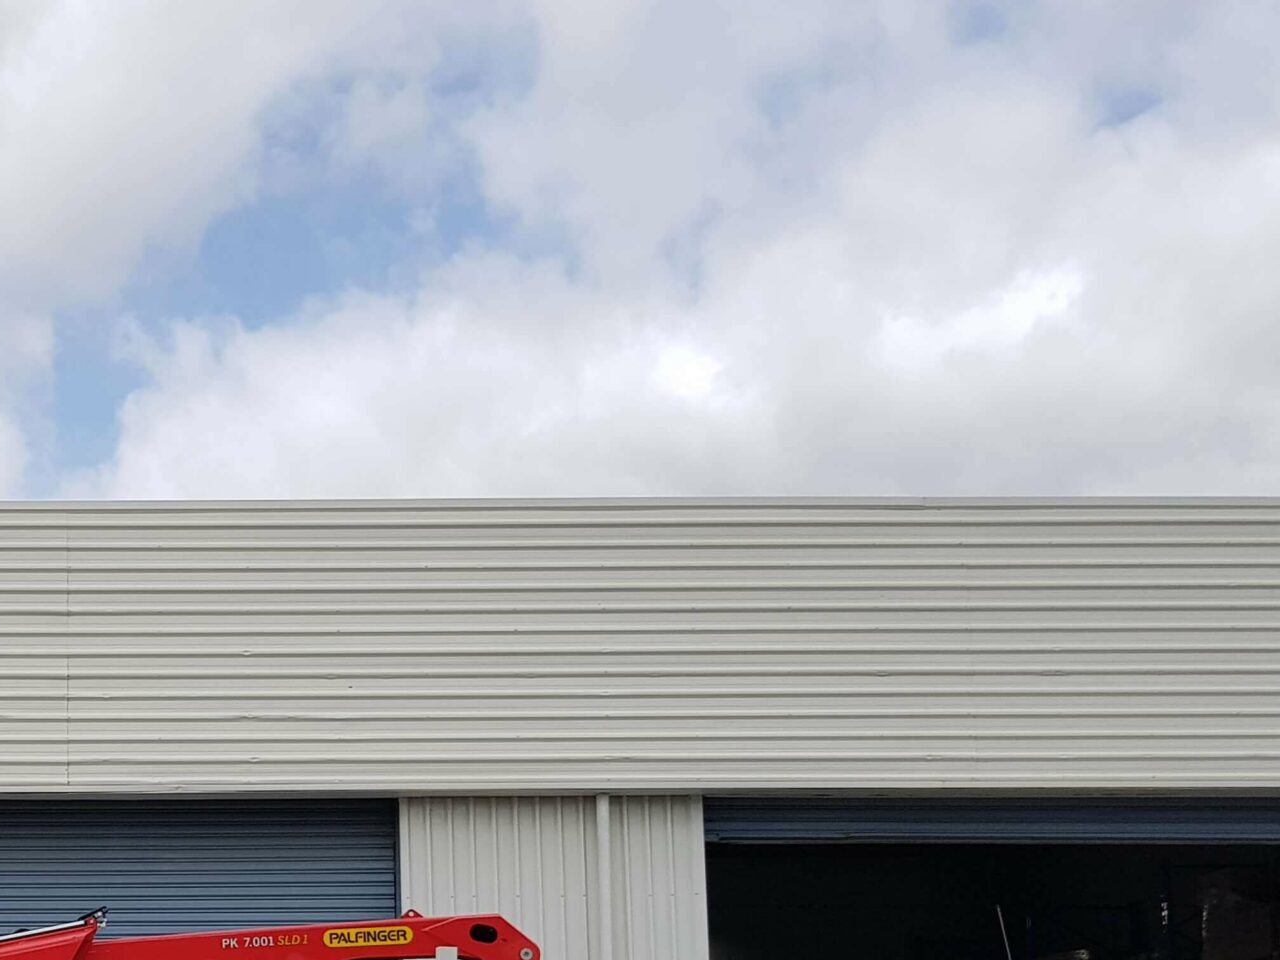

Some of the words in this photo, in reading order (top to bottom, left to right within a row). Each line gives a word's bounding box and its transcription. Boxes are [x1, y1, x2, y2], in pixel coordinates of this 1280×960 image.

[222, 938, 238, 948] PK
[244, 936, 274, 947] 7.001
[277, 934, 301, 945] SLD
[328, 929, 408, 945] PALFINGER
